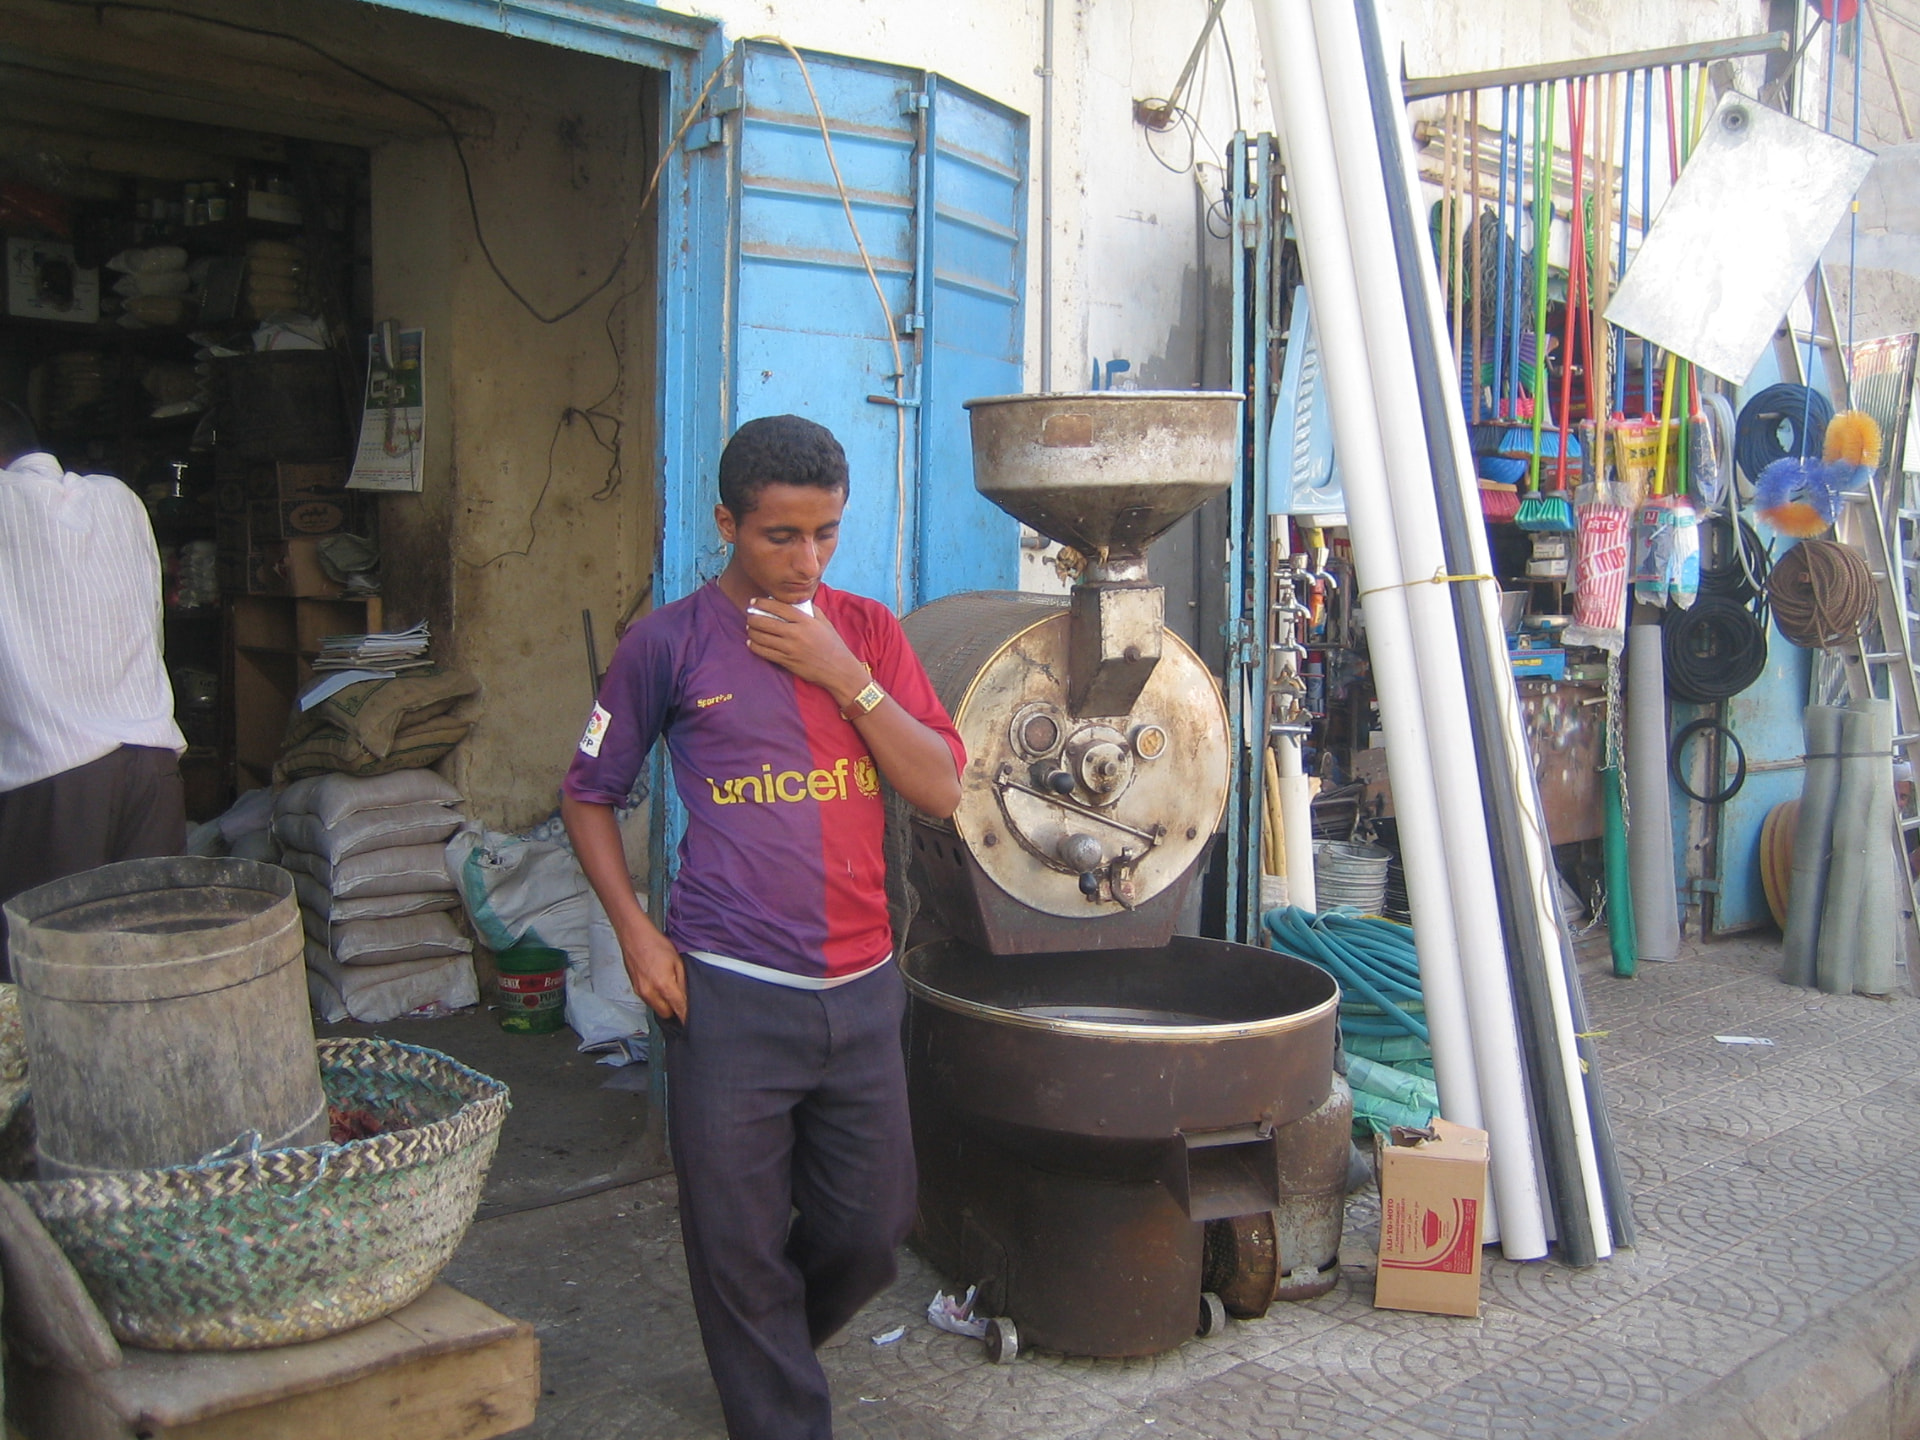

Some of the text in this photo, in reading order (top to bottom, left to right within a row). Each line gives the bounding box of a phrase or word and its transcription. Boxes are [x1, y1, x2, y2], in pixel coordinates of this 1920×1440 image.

[1586, 519, 1616, 531] ARTE
[1594, 547, 1627, 574] MOP
[706, 758, 849, 805] unicef
